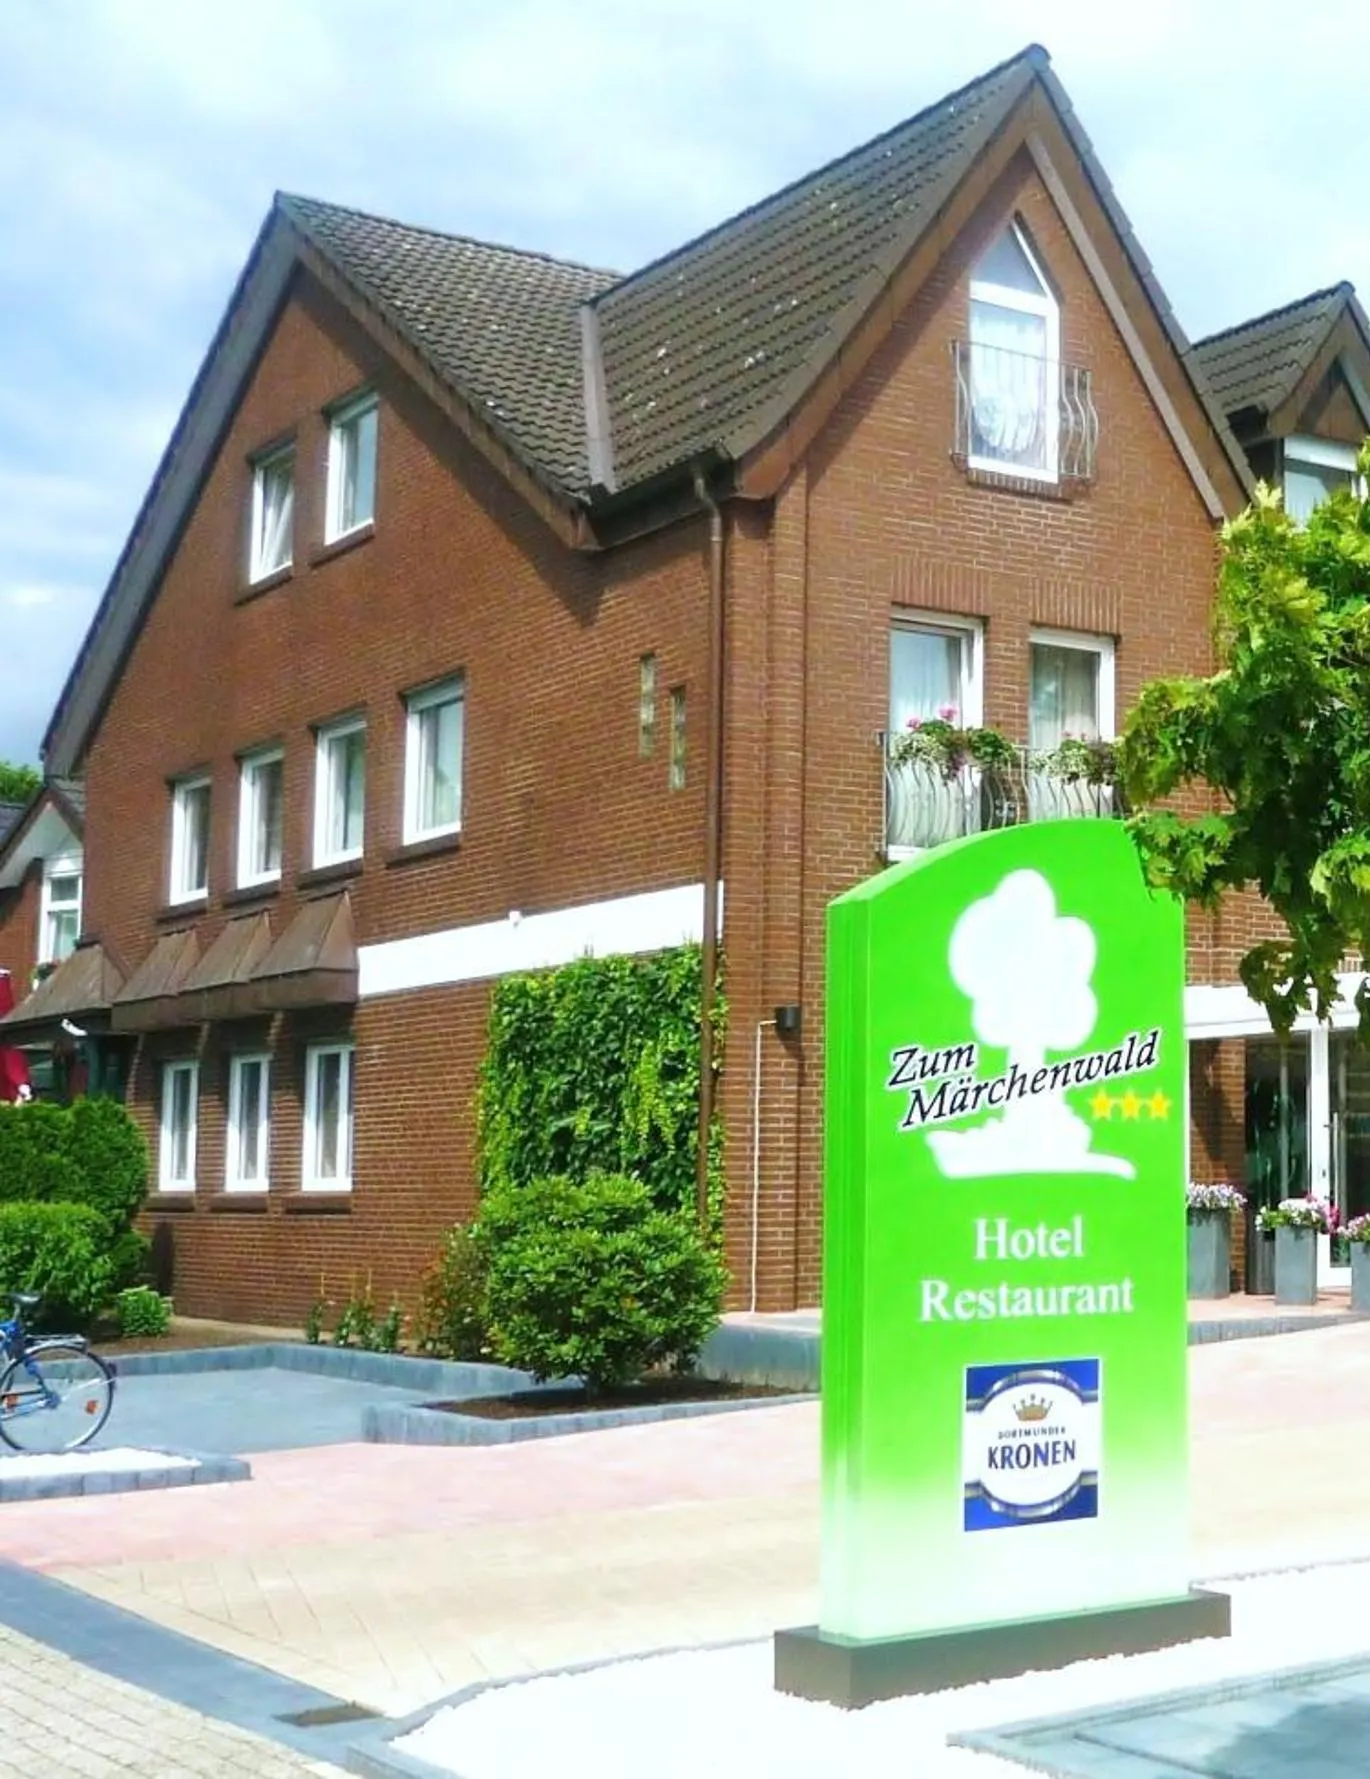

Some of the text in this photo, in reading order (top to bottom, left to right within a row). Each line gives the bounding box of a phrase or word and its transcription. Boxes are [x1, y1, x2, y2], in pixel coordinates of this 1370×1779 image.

[890, 1044, 975, 1086] Zum
[902, 1031, 1159, 1127] Märchenwald
[974, 1216, 1083, 1260] Hotel
[920, 1278, 1133, 1321] Restaurant
[988, 1440, 1076, 1470] KRONEN
